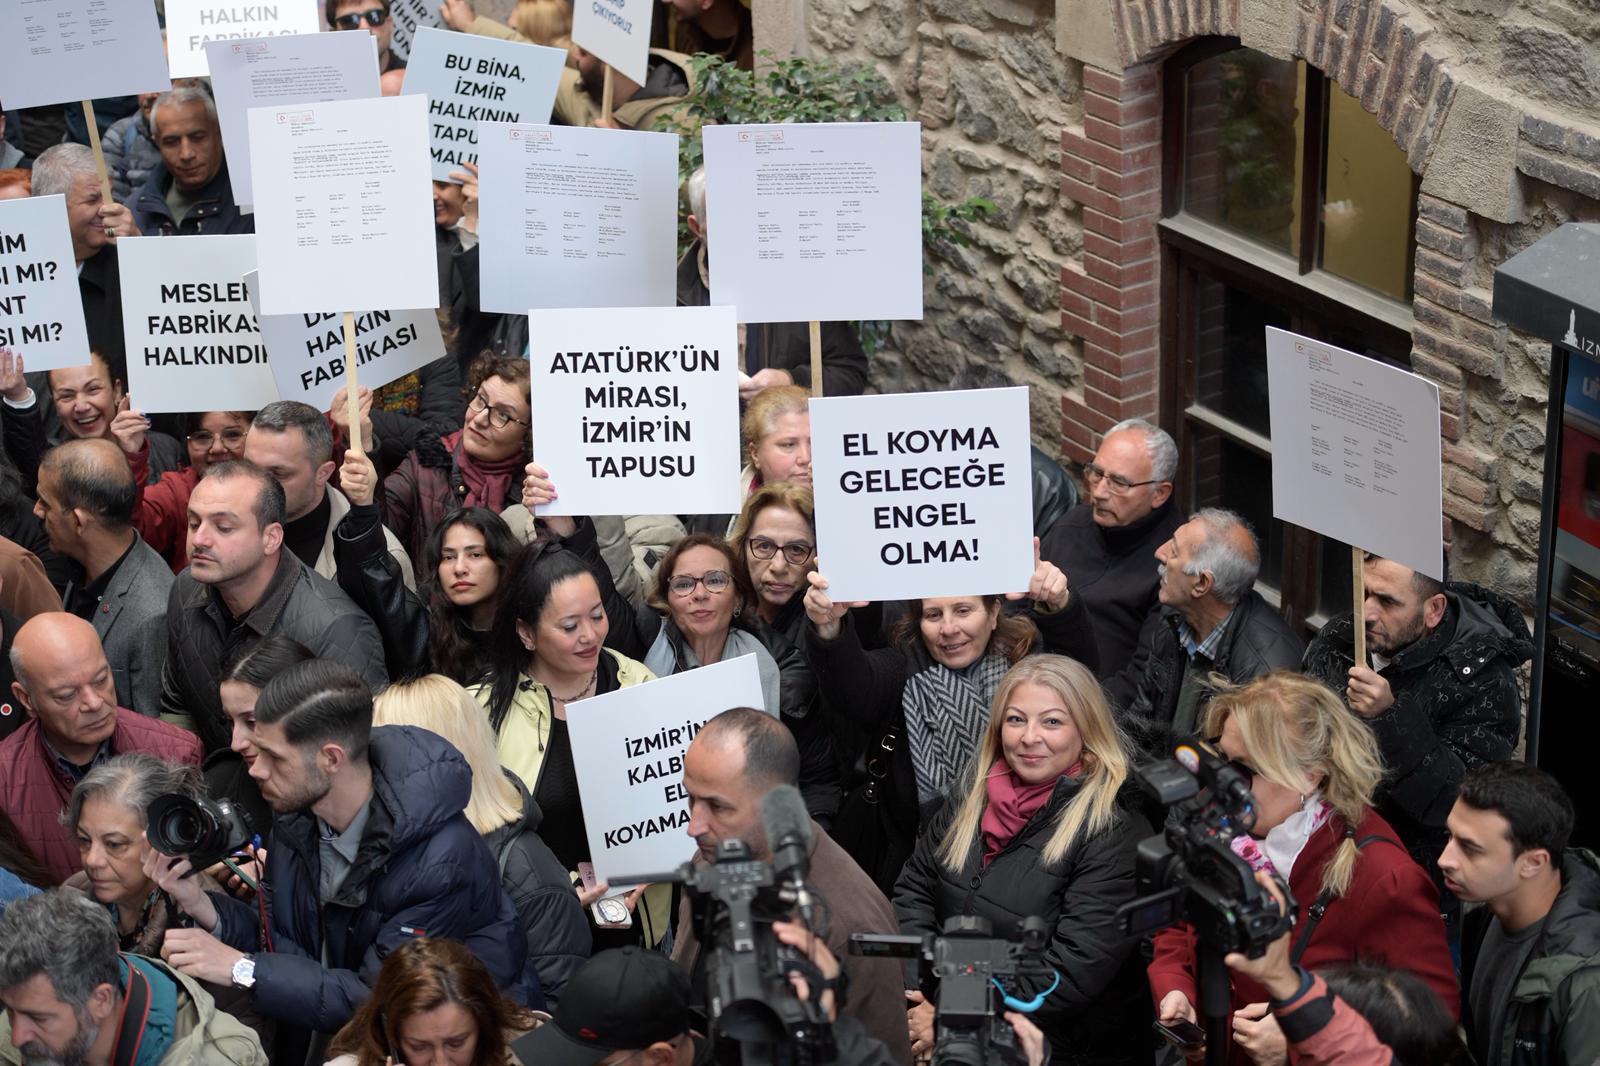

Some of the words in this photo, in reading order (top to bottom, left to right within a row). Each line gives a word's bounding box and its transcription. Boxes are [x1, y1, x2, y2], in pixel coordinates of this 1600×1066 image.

[200, 5, 278, 25] HALKIN
[445, 54, 472, 72] BU
[476, 57, 526, 83] BİNA,
[454, 76, 507, 101] İZMİR
[429, 99, 520, 123] HALKININ
[16, 261, 57, 283] MI?
[22, 322, 62, 344] MI?
[300, 323, 417, 391] FABİKASI
[550, 344, 720, 374] ATATÜRK’ÜN
[585, 381, 687, 410] MİRASI,
[582, 415, 691, 443] İZMİR’İN
[843, 433, 878, 456] EL
[887, 426, 1000, 455] KOYMA
[586, 455, 695, 478] TAPUSU
[840, 458, 1006, 494] GELECEĞE
[874, 502, 976, 529] ENGEL
[880, 538, 979, 565] OLMA!
[664, 783, 689, 804] EL
